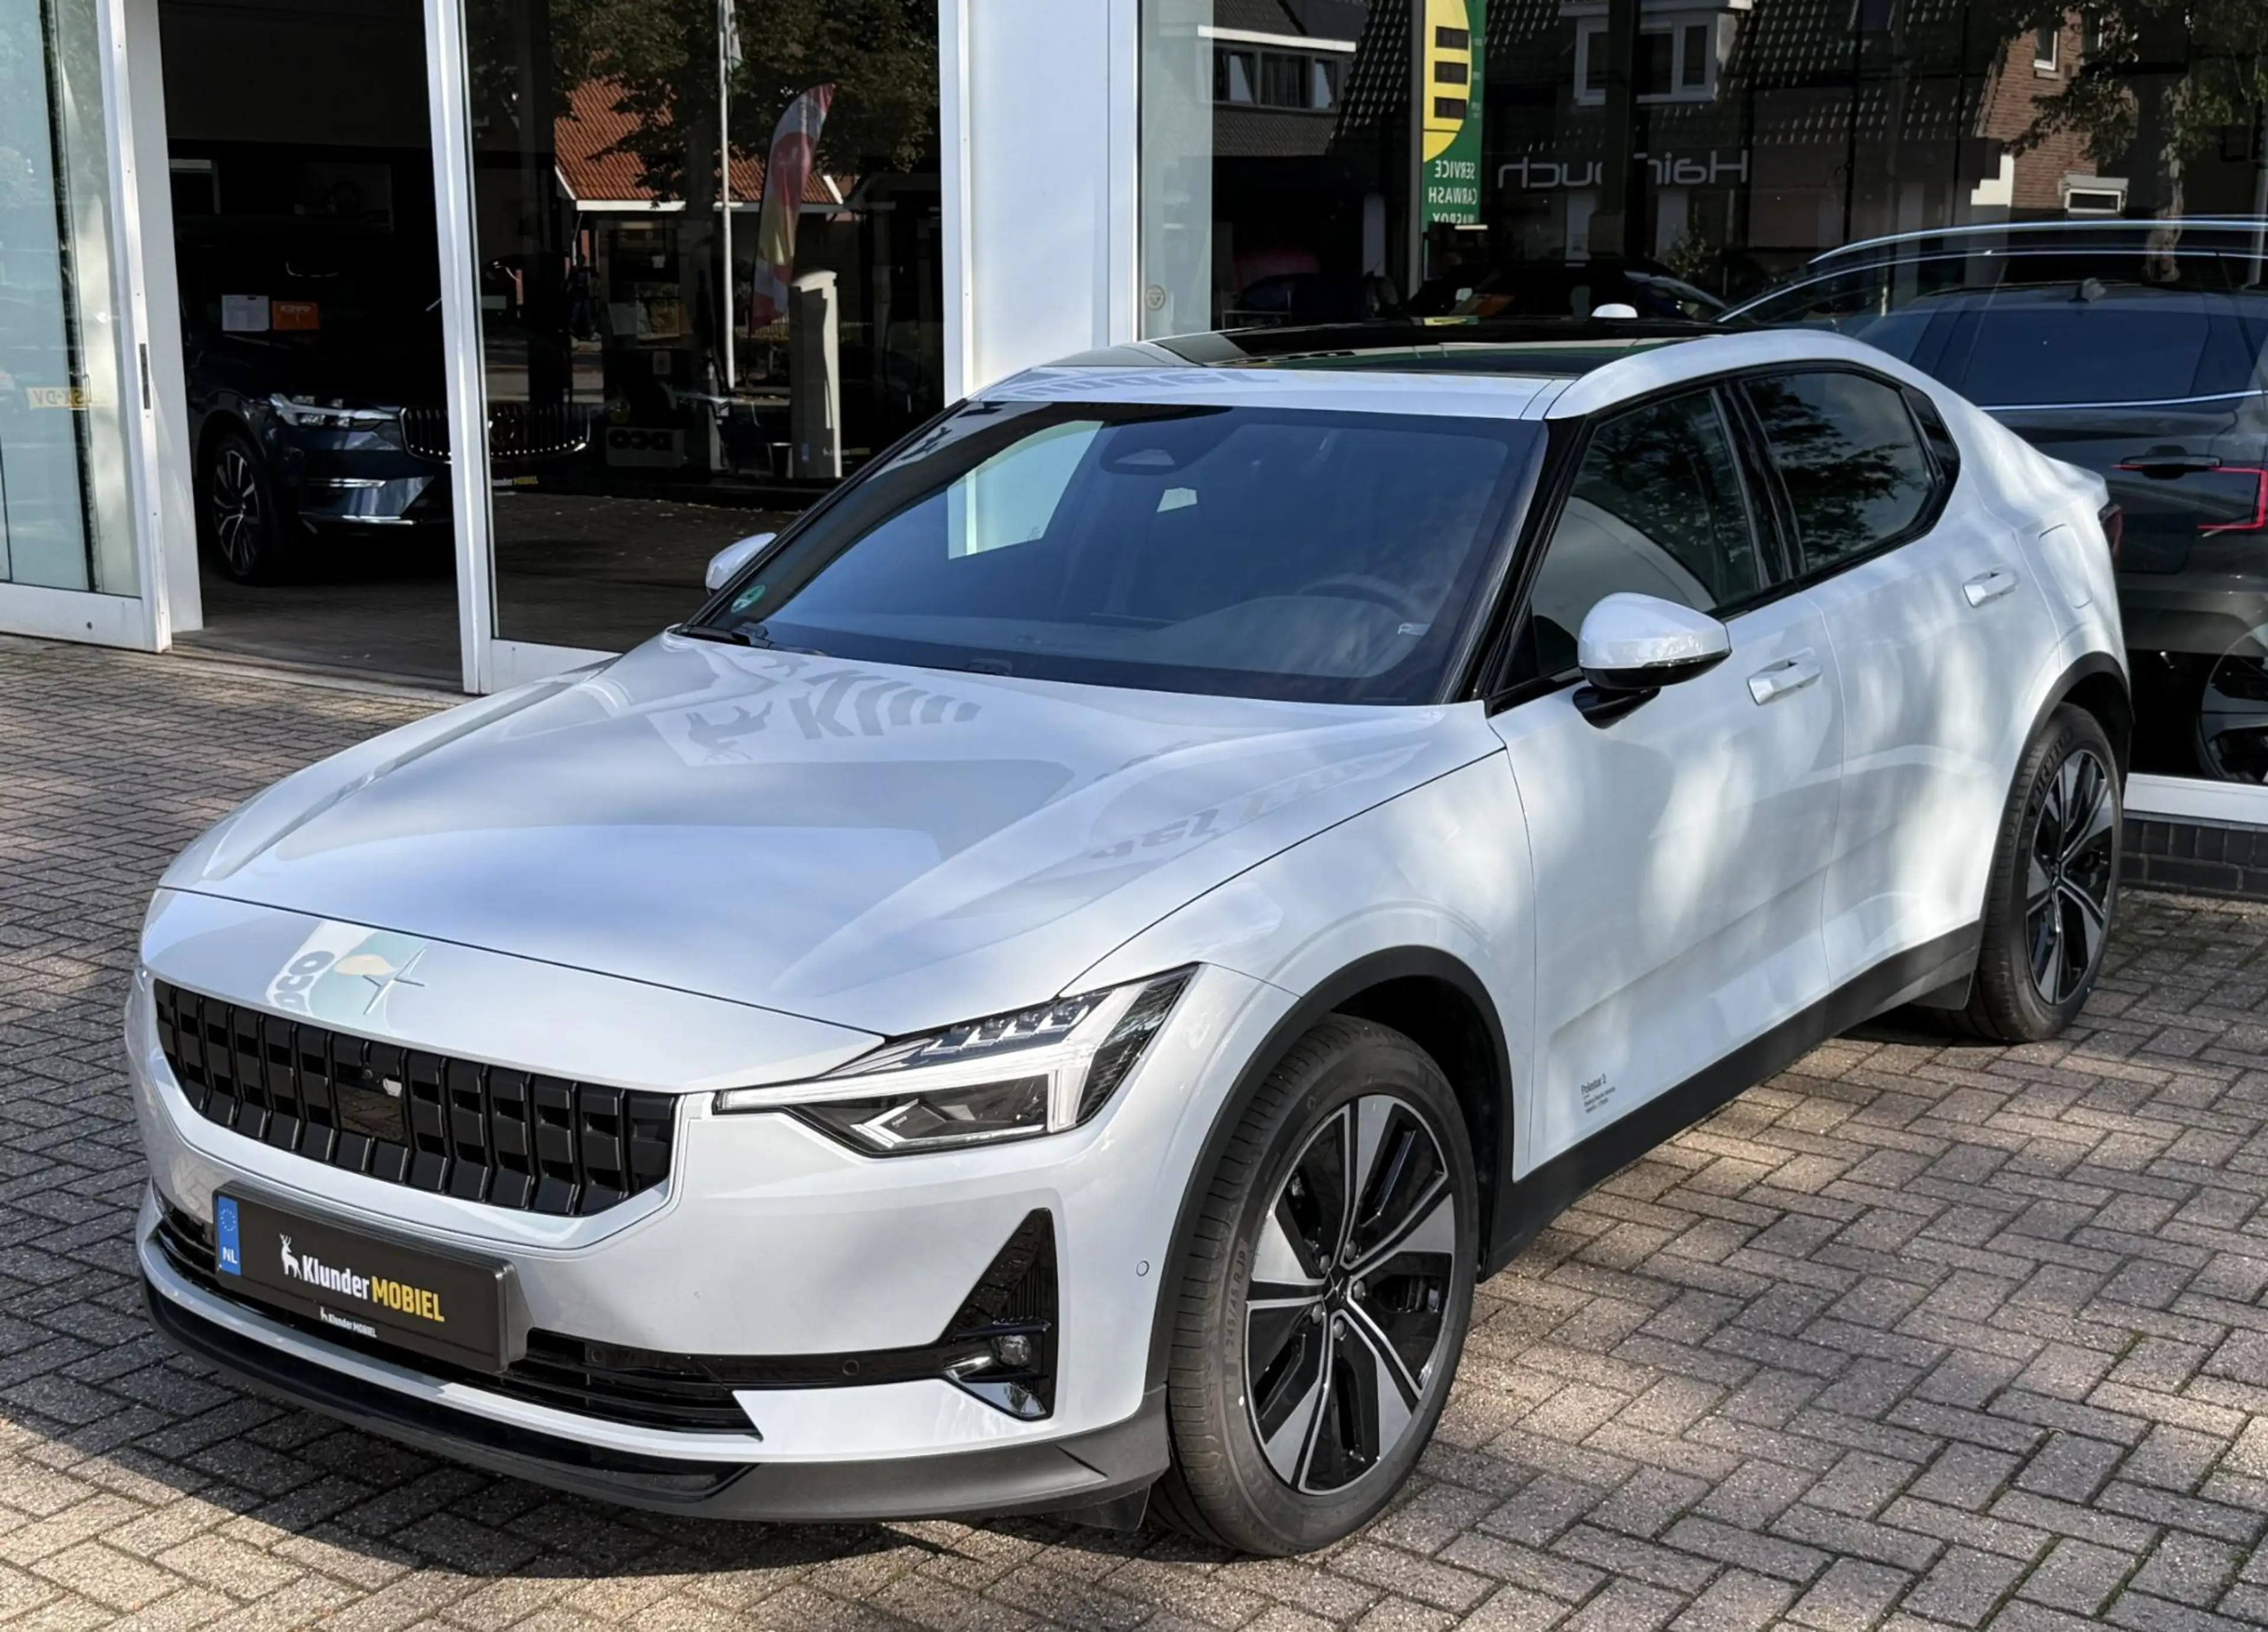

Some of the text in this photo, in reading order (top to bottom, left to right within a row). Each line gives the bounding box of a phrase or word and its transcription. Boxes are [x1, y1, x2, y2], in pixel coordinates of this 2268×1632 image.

[223, 1246, 237, 1264] NL
[302, 1255, 445, 1322] Klunder MOBIEL
